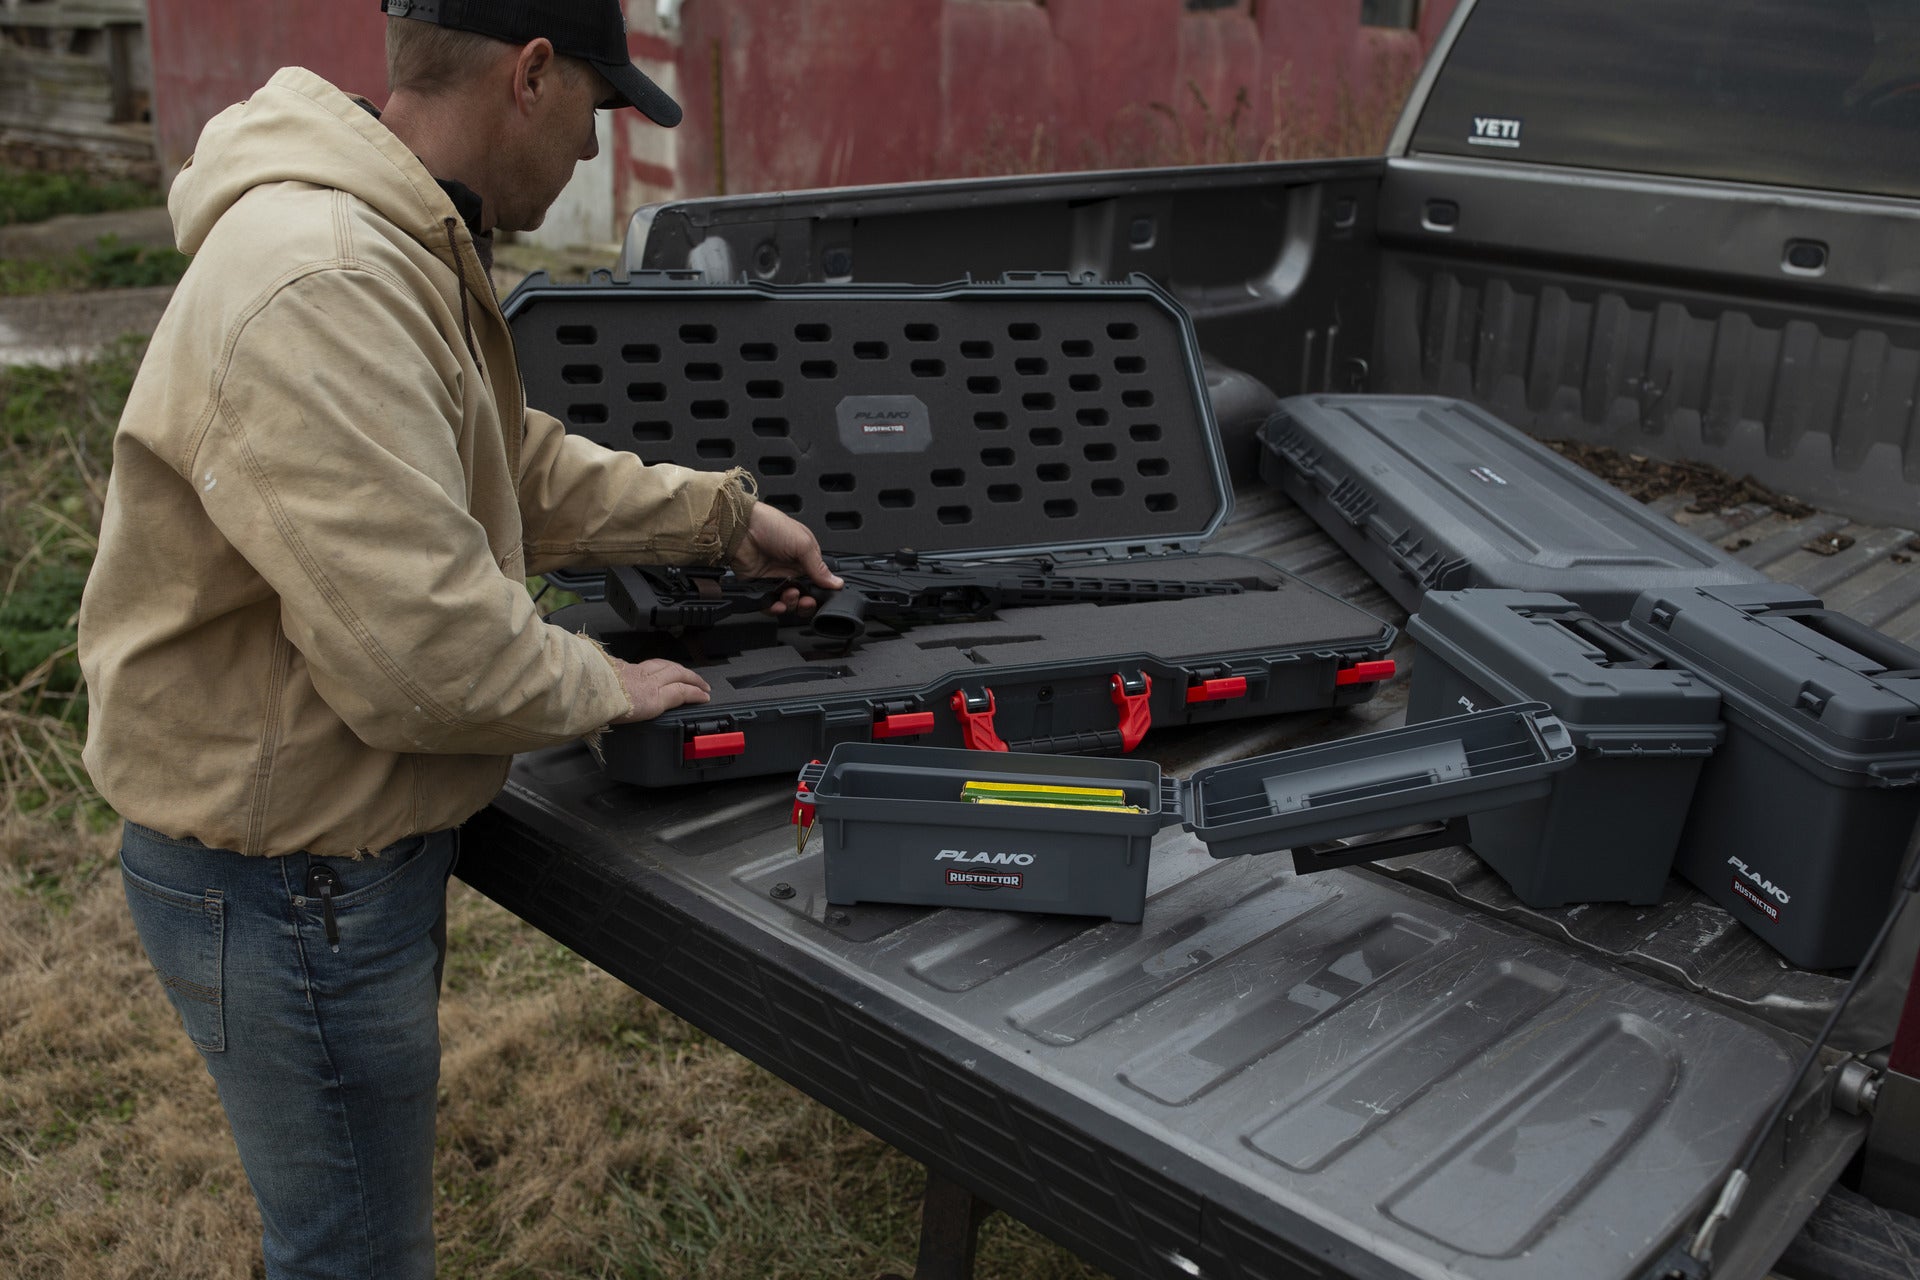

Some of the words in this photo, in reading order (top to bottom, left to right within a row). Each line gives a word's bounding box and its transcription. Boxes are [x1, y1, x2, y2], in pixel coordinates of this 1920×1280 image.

[1474, 117, 1520, 138] YETI
[854, 411, 910, 419] PLANO
[934, 849, 1034, 866] PLANO
[949, 872, 1019, 886] RUSTRICTOR
[1727, 855, 1789, 904] PLANO
[1734, 880, 1777, 919] RUSTRICTOR
